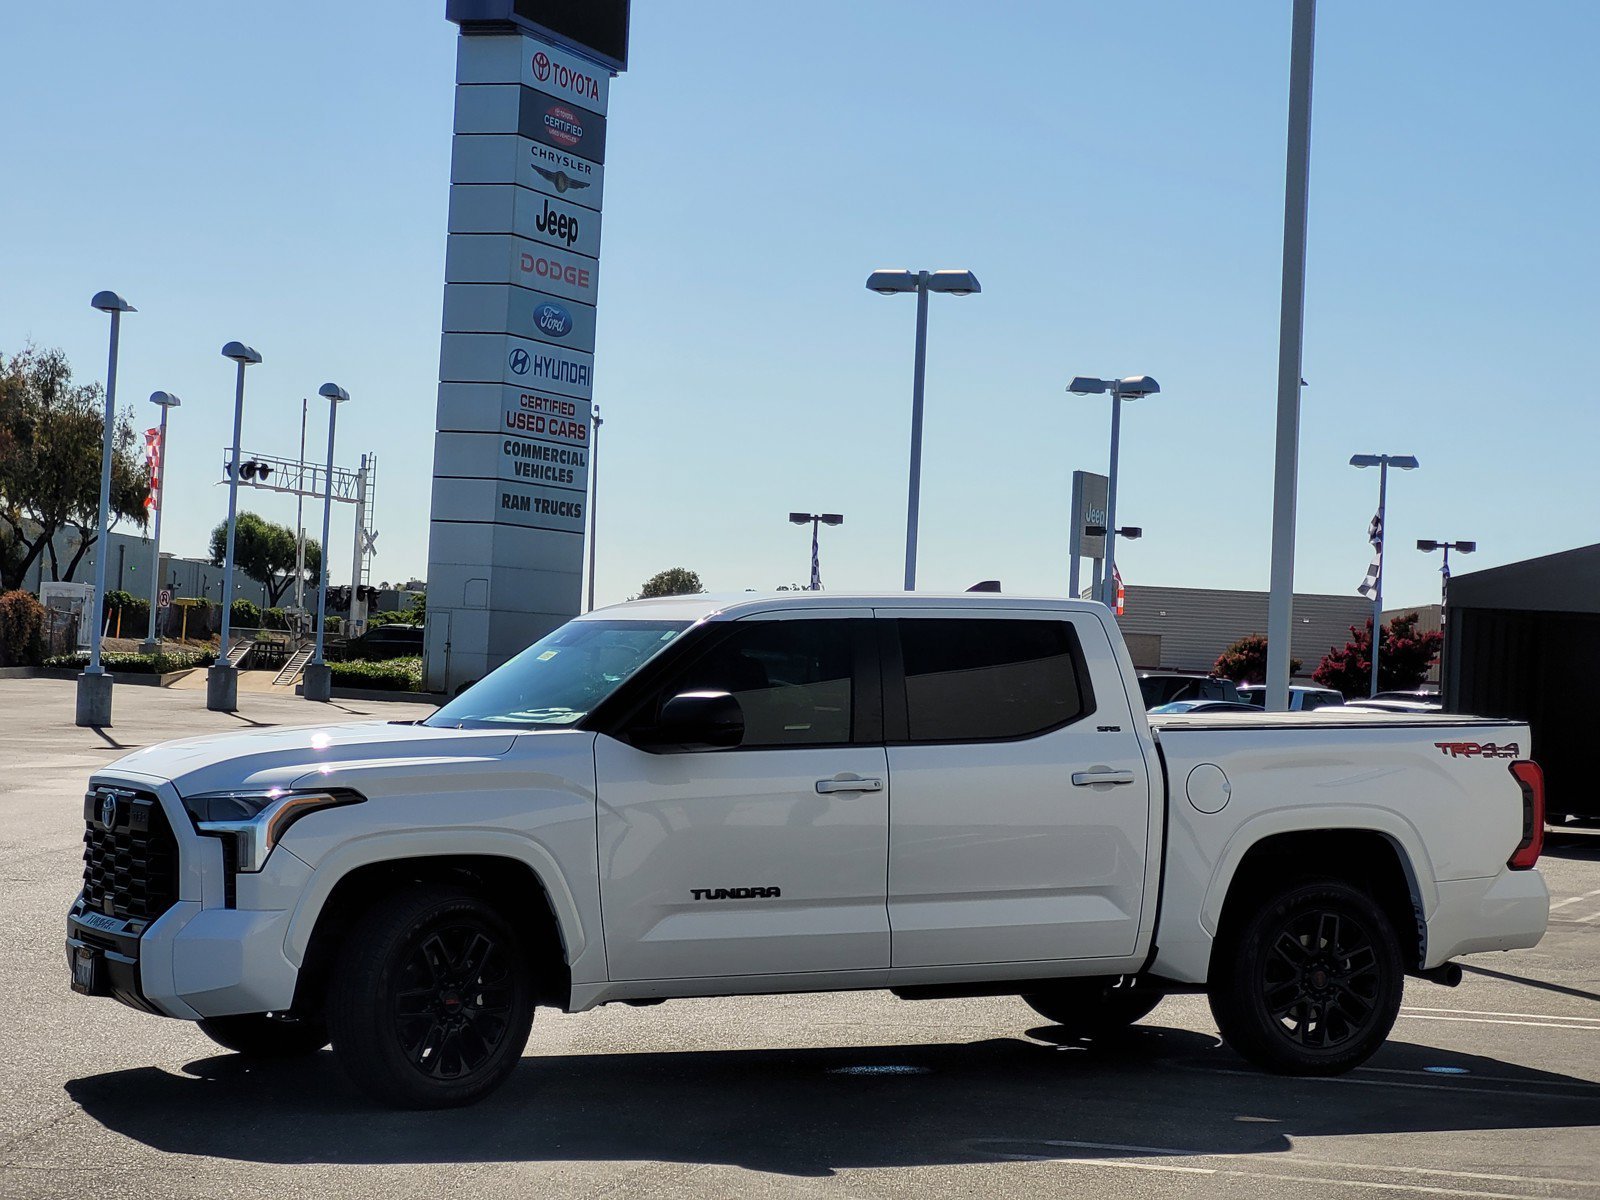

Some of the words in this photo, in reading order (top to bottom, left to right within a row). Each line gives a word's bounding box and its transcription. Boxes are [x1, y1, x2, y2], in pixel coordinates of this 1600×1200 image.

[554, 63, 599, 101] TOYOTA
[543, 114, 583, 137] CERTIFIED
[531, 146, 592, 175] CHRYSLER
[535, 199, 579, 246] Jeep
[521, 254, 589, 287] DODGE
[540, 306, 565, 333] Ford
[534, 355, 590, 386] HYUNDAI
[520, 393, 576, 417] CERTIFIED
[507, 411, 546, 433] USED
[549, 419, 586, 440] CARS
[504, 441, 585, 466] COMMERCIAL
[514, 461, 574, 484] VEHICLES
[502, 494, 530, 511] RAM
[534, 499, 581, 518] TRUCKS
[1085, 502, 1105, 525] Jeep
[1434, 742, 1482, 758] TRD
[690, 887, 781, 900] TUNDRA
